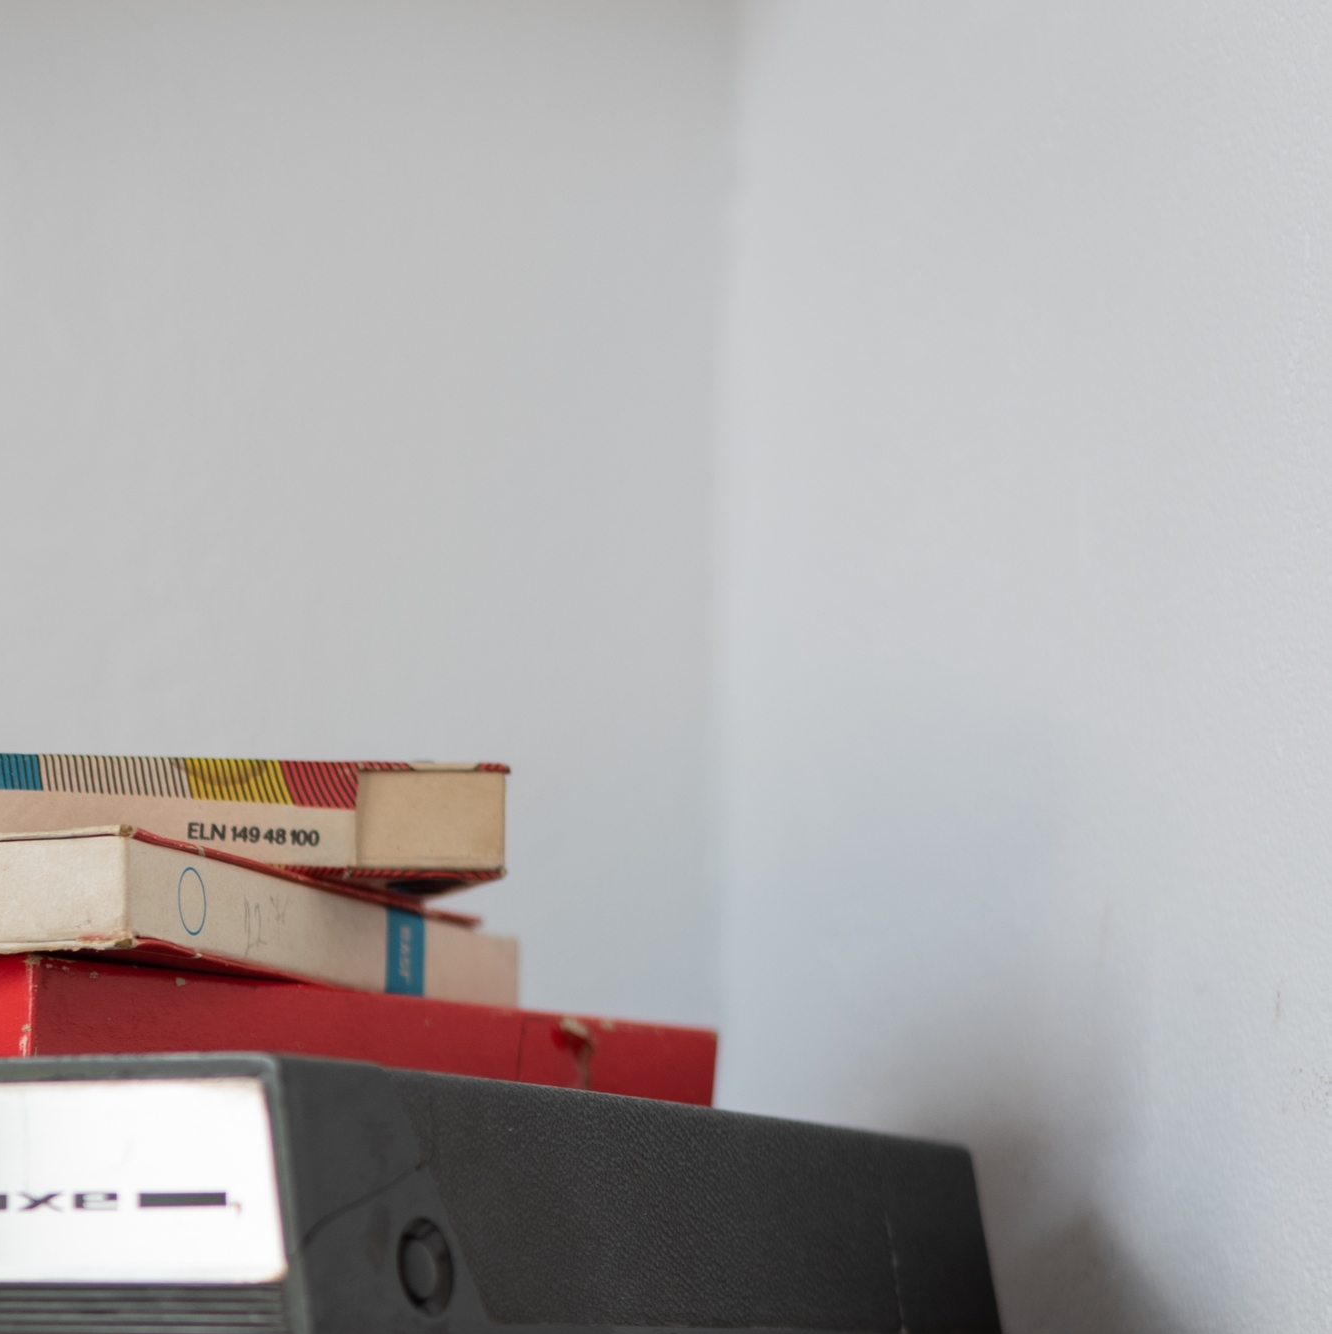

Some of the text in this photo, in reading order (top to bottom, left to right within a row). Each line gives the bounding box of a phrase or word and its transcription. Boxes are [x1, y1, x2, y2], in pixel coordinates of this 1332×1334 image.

[187, 822, 320, 847] ELN 149 48 100
